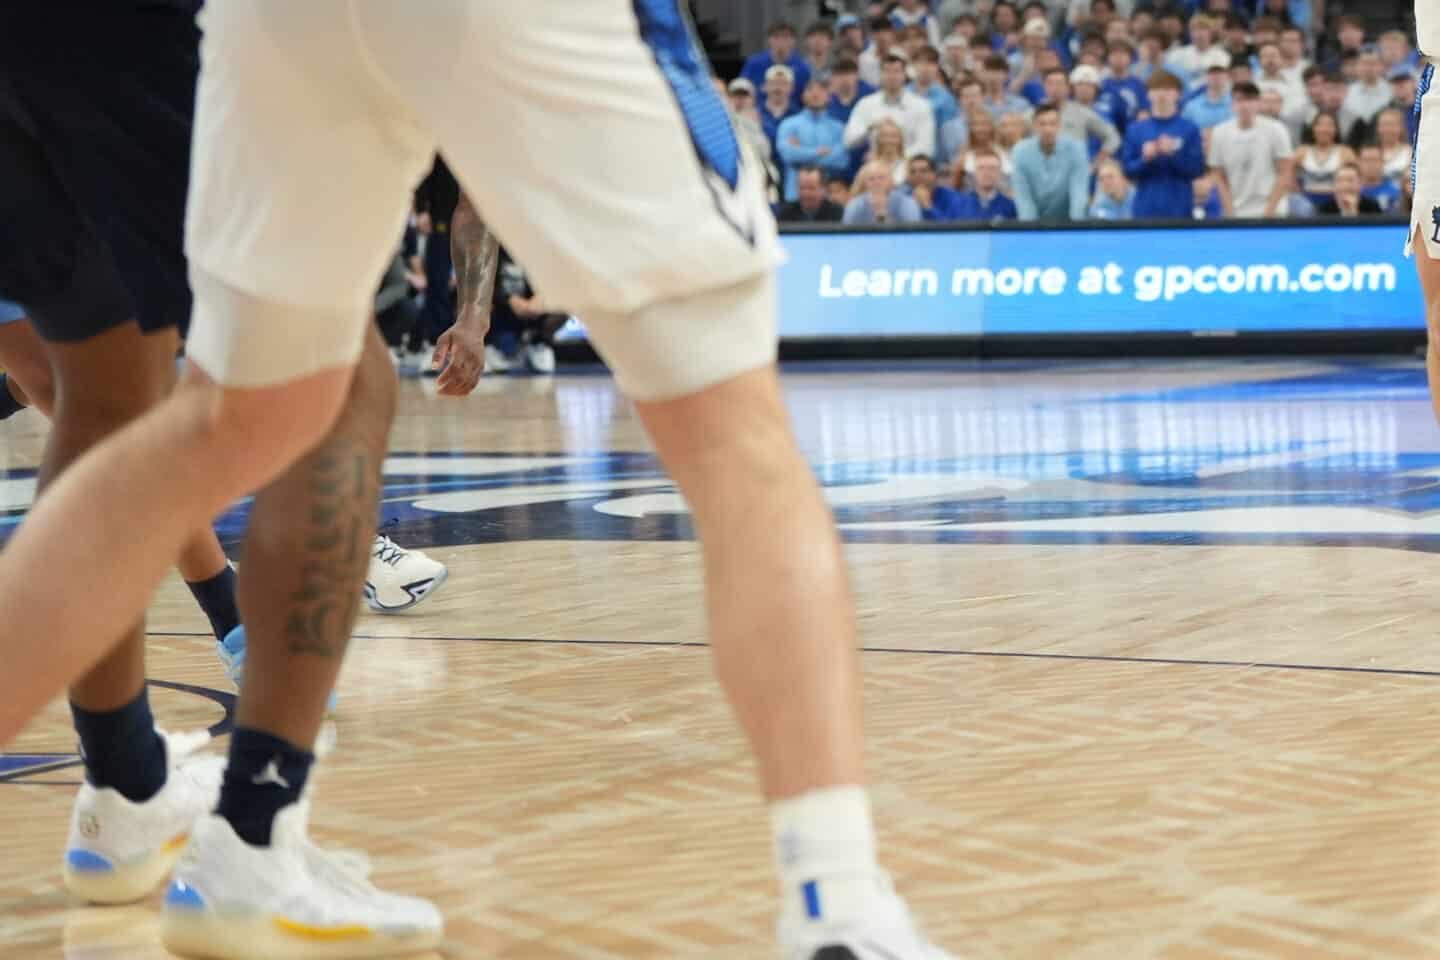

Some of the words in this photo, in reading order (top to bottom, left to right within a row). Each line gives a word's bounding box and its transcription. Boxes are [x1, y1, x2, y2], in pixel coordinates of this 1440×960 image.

[818, 263, 938, 299] Learn
[952, 266, 1067, 296] more
[1078, 263, 1122, 293] at
[1134, 261, 1397, 302] gpcom.com
